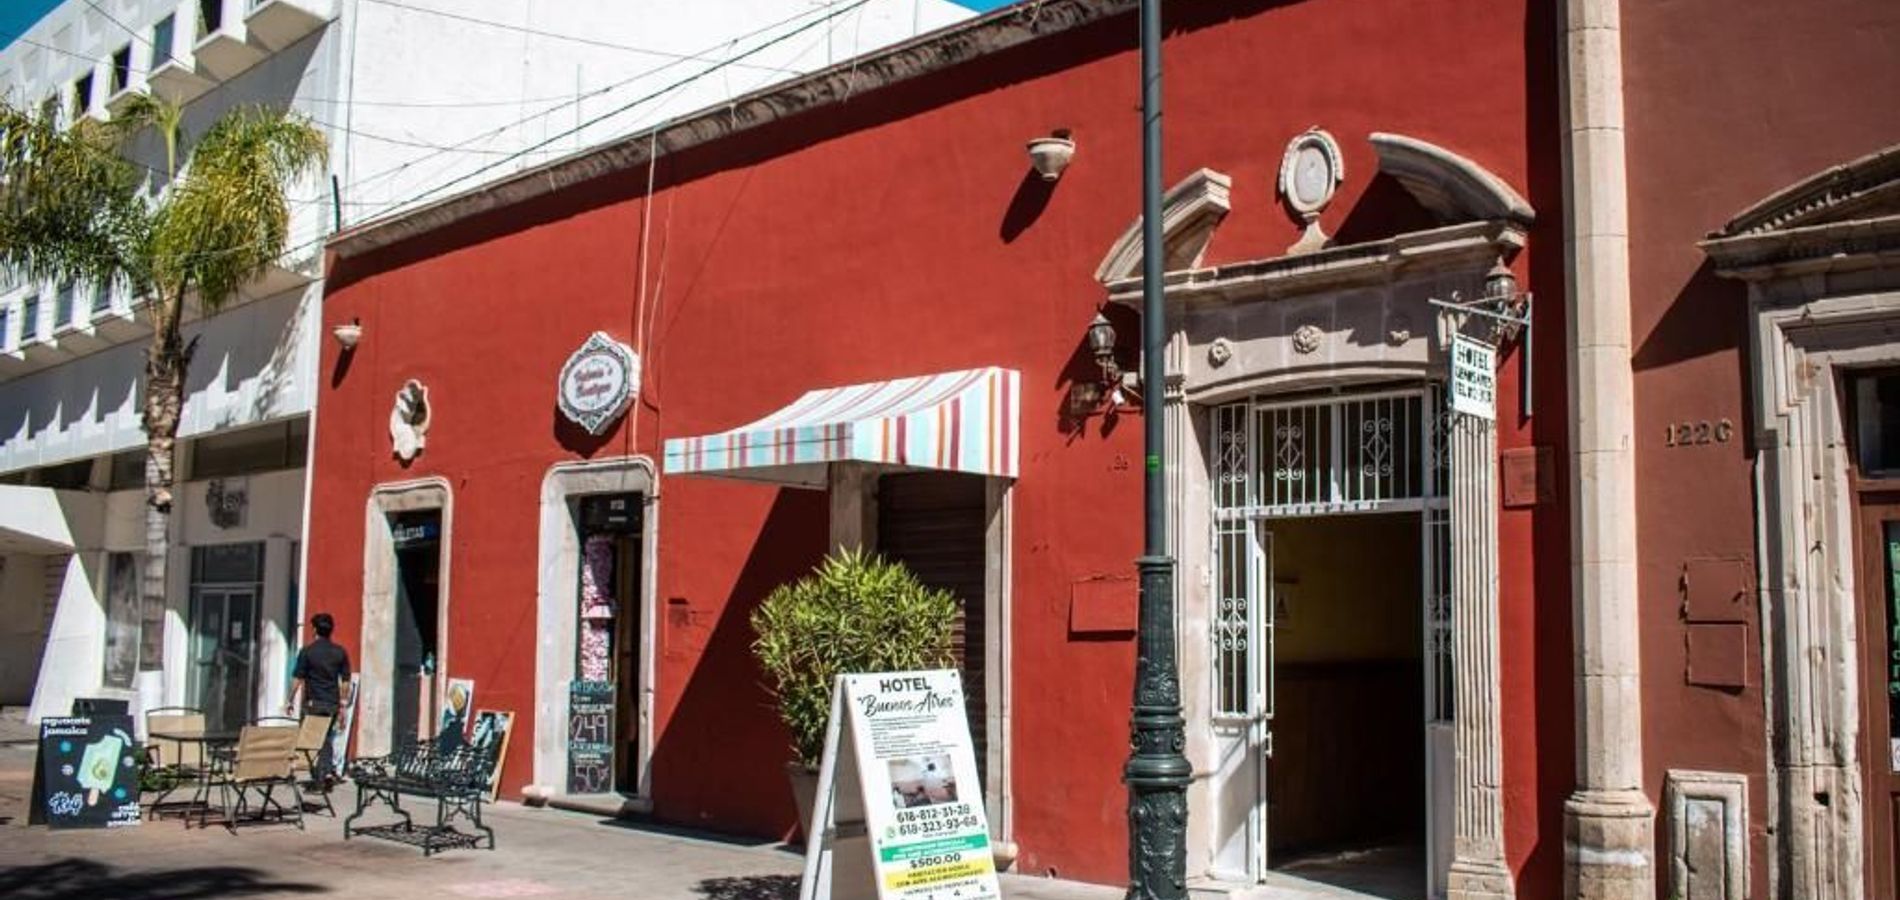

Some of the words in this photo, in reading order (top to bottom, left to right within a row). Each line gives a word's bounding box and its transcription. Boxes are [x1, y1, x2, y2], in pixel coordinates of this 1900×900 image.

[1457, 344, 1489, 370] HOTEL
[880, 677, 932, 693] HOTEL
[43, 726, 88, 738] jamaica
[910, 853, 961, 869] $500.00
